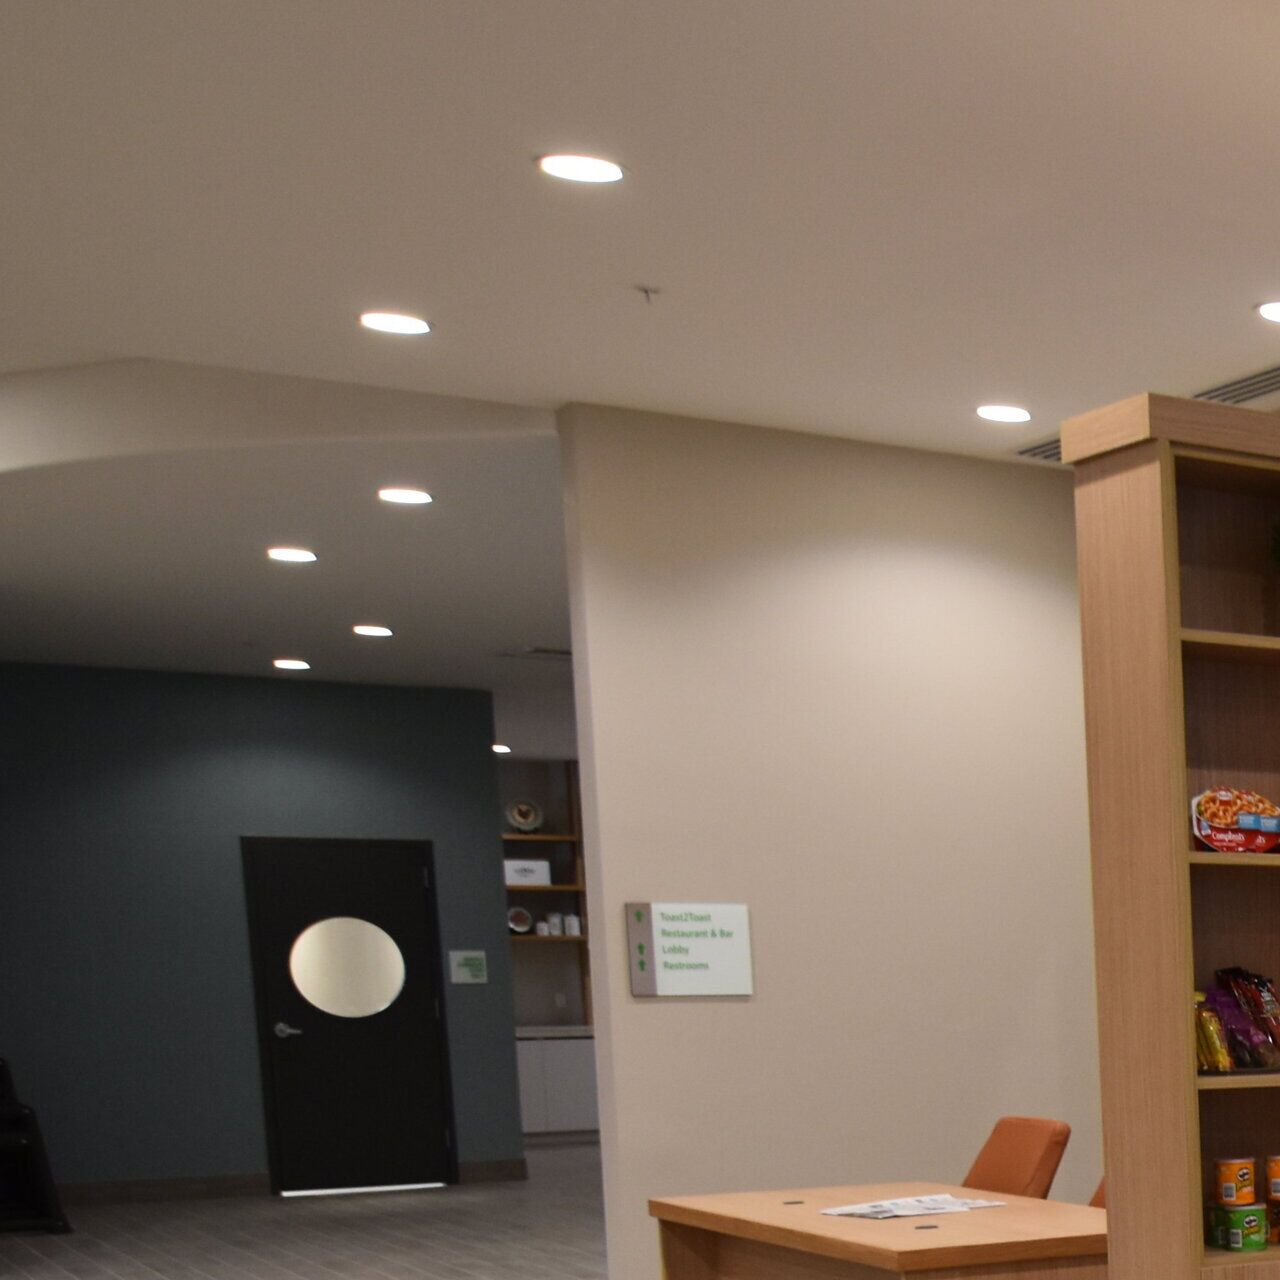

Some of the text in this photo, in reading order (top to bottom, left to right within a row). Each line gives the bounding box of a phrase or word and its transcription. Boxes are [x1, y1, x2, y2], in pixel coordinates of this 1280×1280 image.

[661, 912, 712, 923] Toast2Toast
[661, 928, 734, 939] Restaurant & Bar
[662, 945, 690, 956] Lobby
[663, 961, 710, 971] Restrooms
